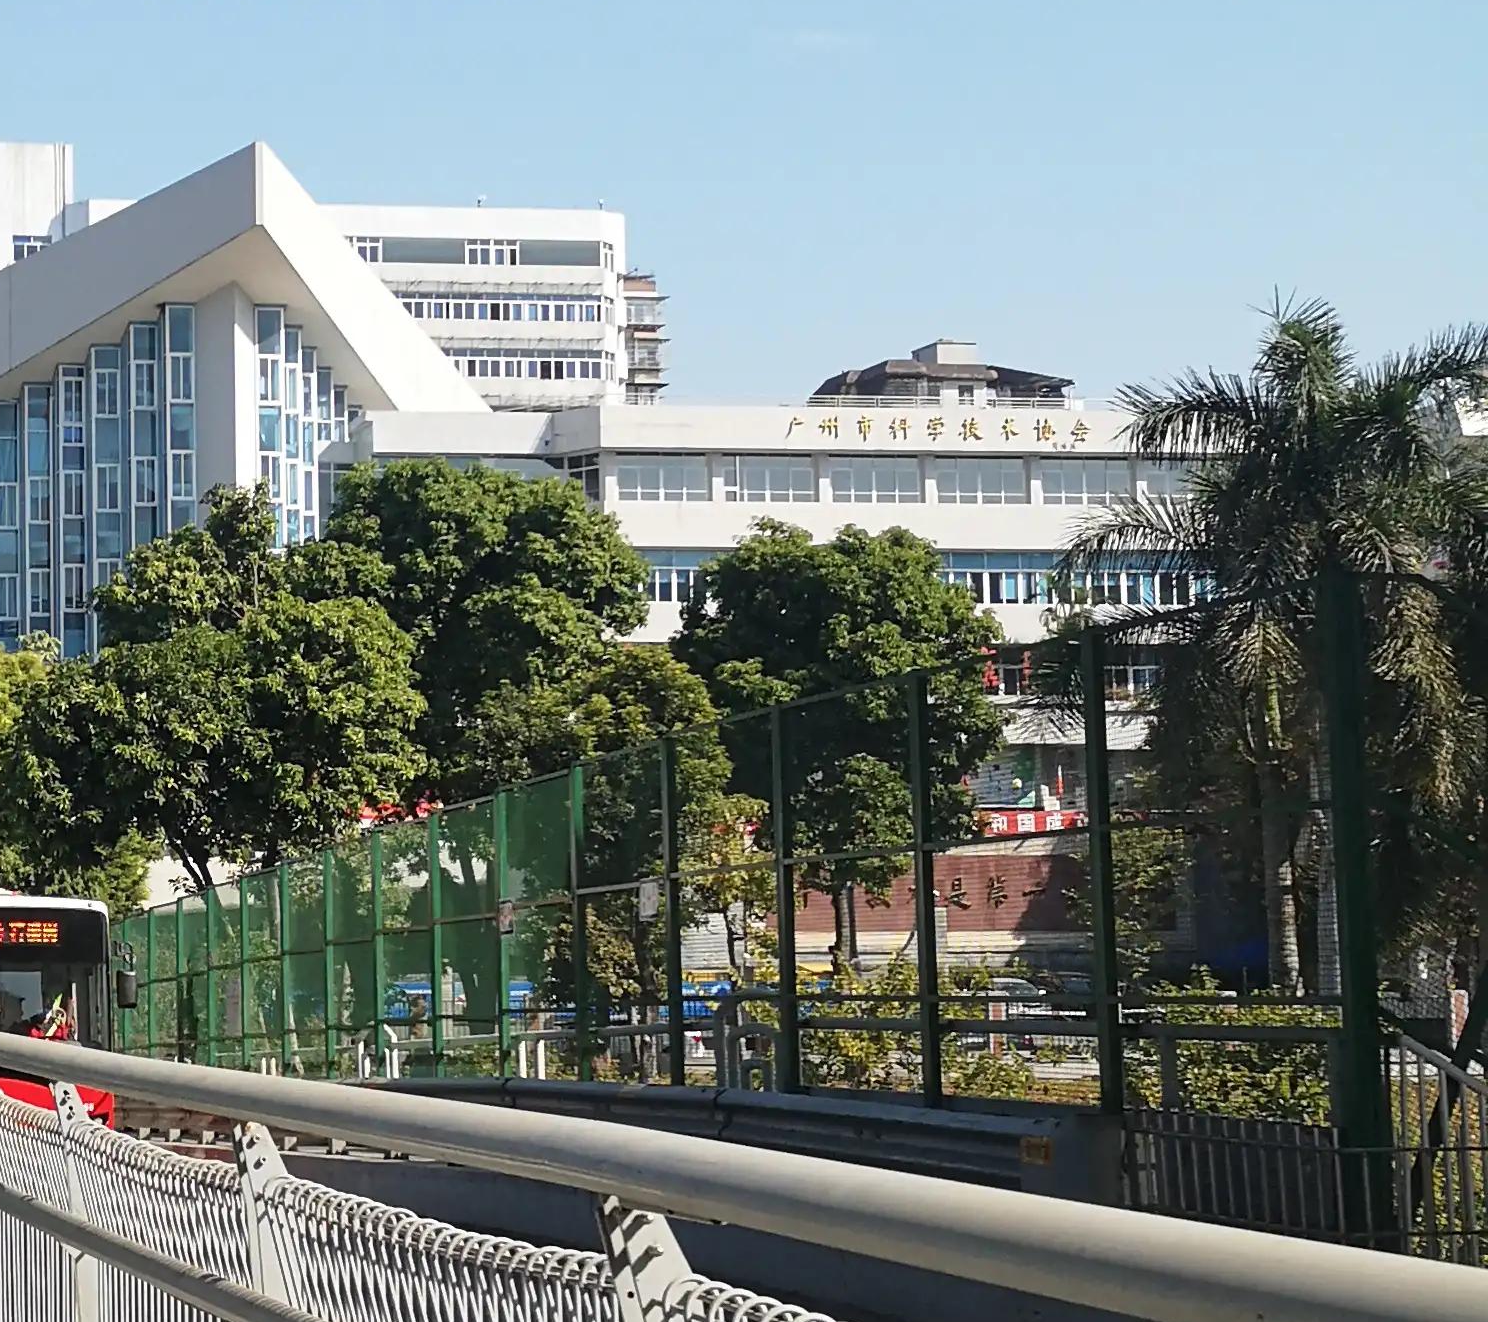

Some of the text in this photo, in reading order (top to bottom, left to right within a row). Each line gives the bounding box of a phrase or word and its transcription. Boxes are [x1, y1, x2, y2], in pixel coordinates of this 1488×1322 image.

[785, 415, 1092, 443] 广州市科学技术协会
